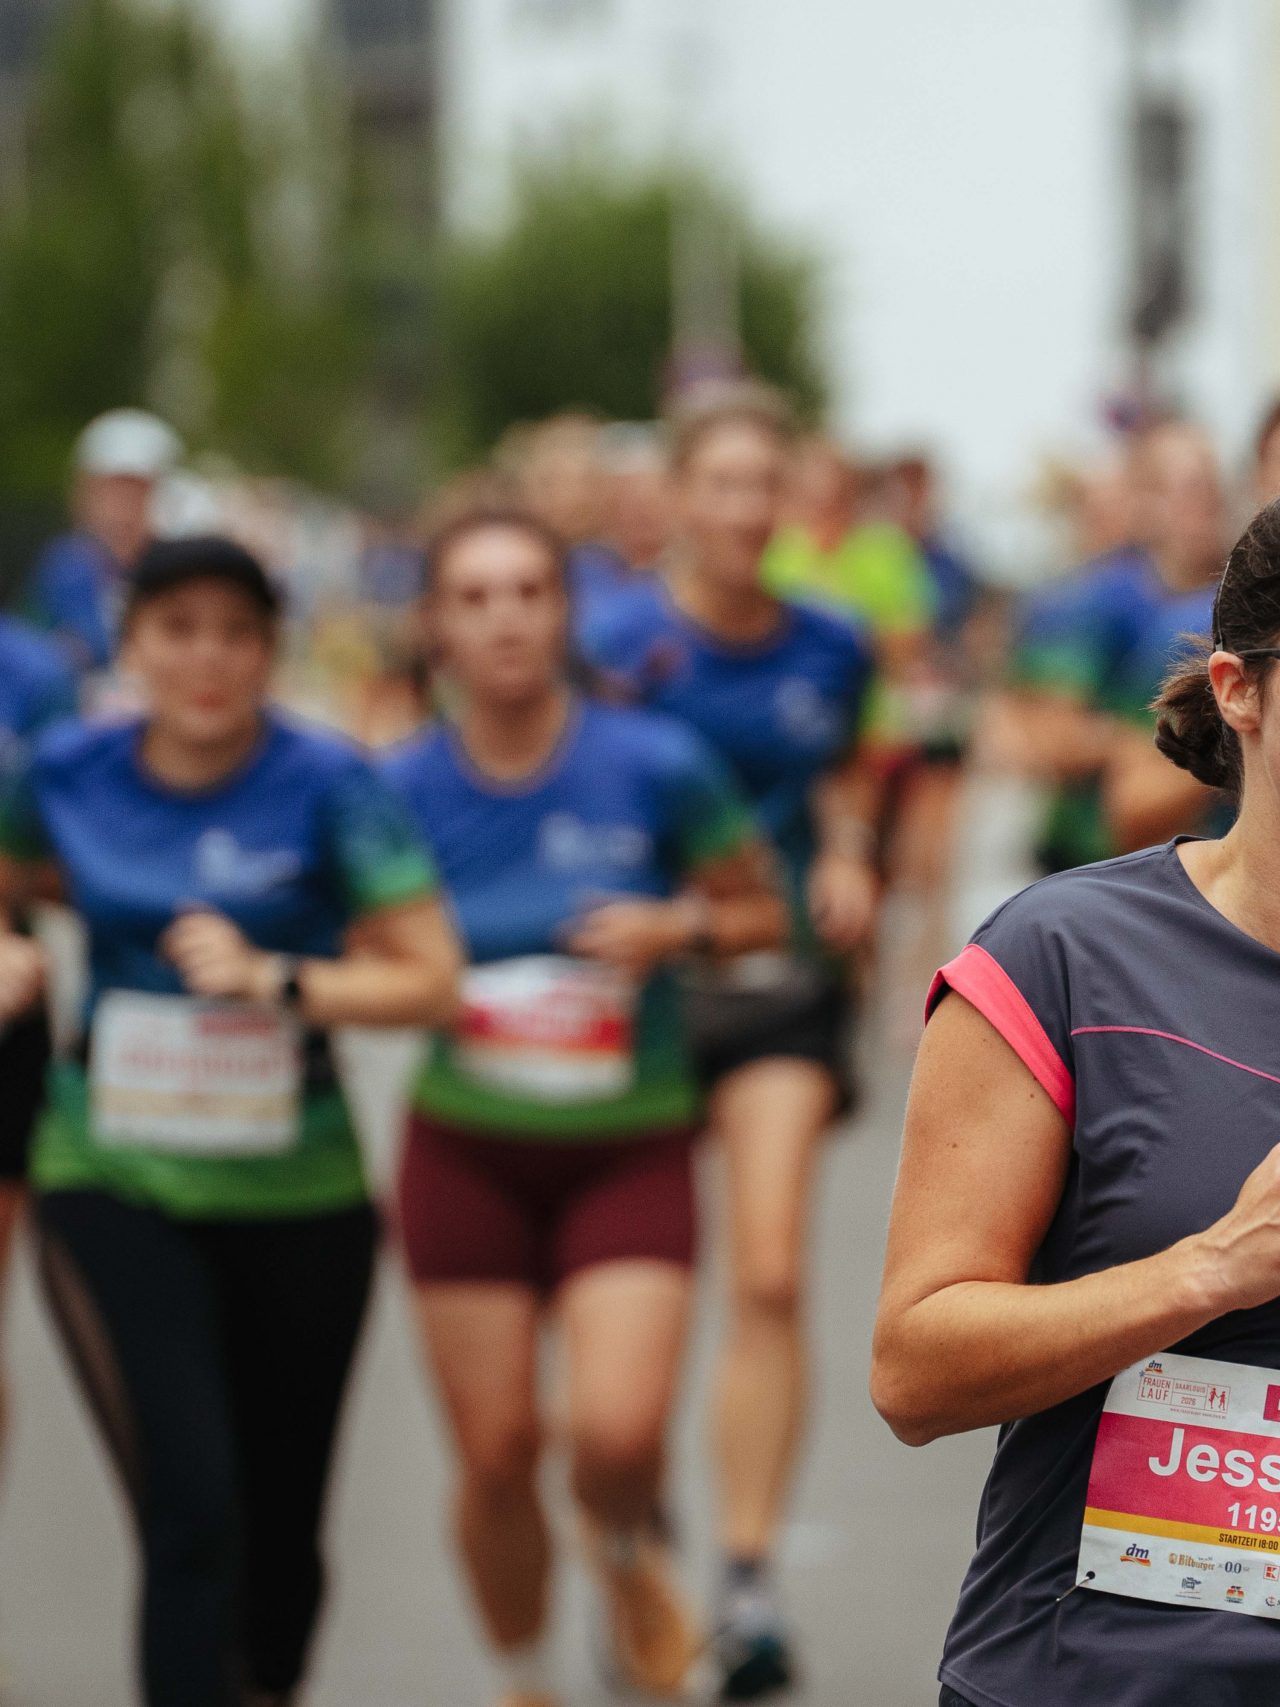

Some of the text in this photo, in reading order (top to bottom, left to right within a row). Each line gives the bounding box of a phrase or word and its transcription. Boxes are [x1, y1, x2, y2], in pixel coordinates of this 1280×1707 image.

[1143, 1376, 1171, 1390] FRAUEN
[1141, 1387, 1169, 1401] LAUF
[1218, 1533, 1258, 1548] STARTZEIT
[1258, 1539, 1279, 1551] 18:00
[1125, 1543, 1150, 1559] dm
[1178, 1554, 1216, 1571] Bitburger
